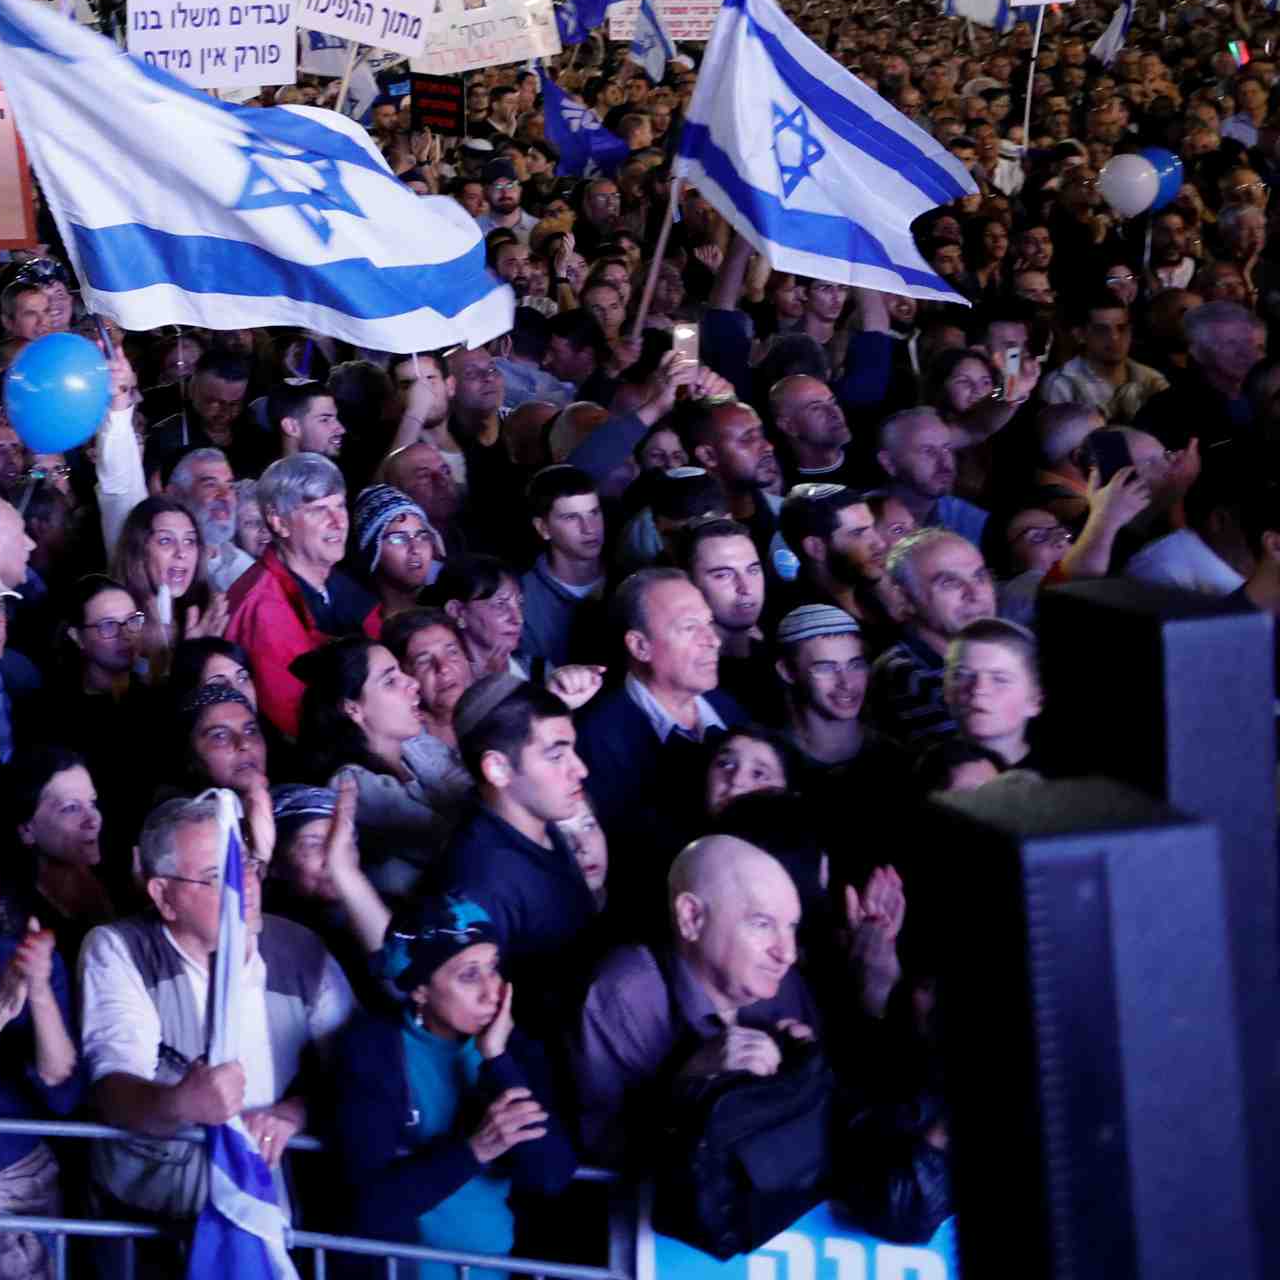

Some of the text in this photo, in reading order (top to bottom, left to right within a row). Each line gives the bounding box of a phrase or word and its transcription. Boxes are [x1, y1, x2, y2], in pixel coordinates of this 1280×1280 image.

[133, 1, 291, 31] עבדים משלו בנו
[380, 7, 422, 39] מתוך
[200, 46, 227, 74] אין
[234, 44, 281, 73] פורק
